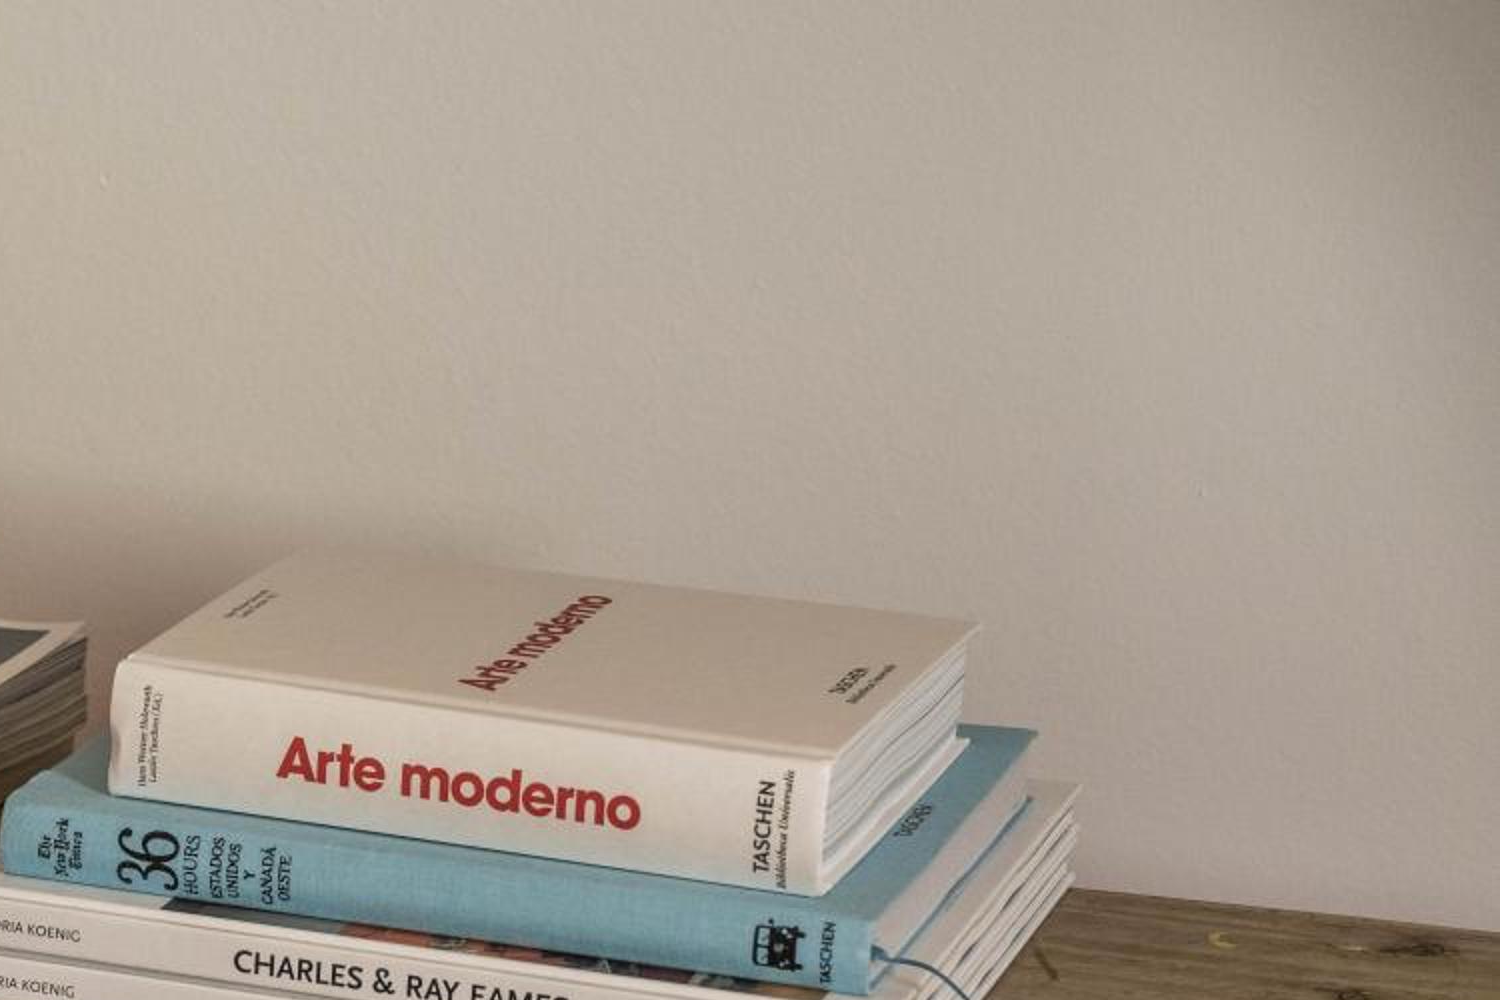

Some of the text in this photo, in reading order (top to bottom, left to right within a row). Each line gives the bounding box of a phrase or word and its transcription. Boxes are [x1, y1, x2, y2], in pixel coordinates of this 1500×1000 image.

[457, 594, 613, 692] Arte moderno
[276, 736, 641, 831] Arte moderno
[752, 780, 776, 873] TASCHEN
[117, 827, 181, 891] 36
[182, 835, 200, 895] HOURS
[211, 836, 226, 899] ESTADOS
[227, 843, 242, 898] UNIDOS
[243, 869, 255, 880] Y
[277, 855, 292, 901] OESTE
[27, 923, 81, 943] KOENIG
[820, 921, 836, 985] TASCHEN
[21, 979, 76, 999] KOENIG
[233, 950, 364, 990] CHARLES
[372, 967, 395, 995] &
